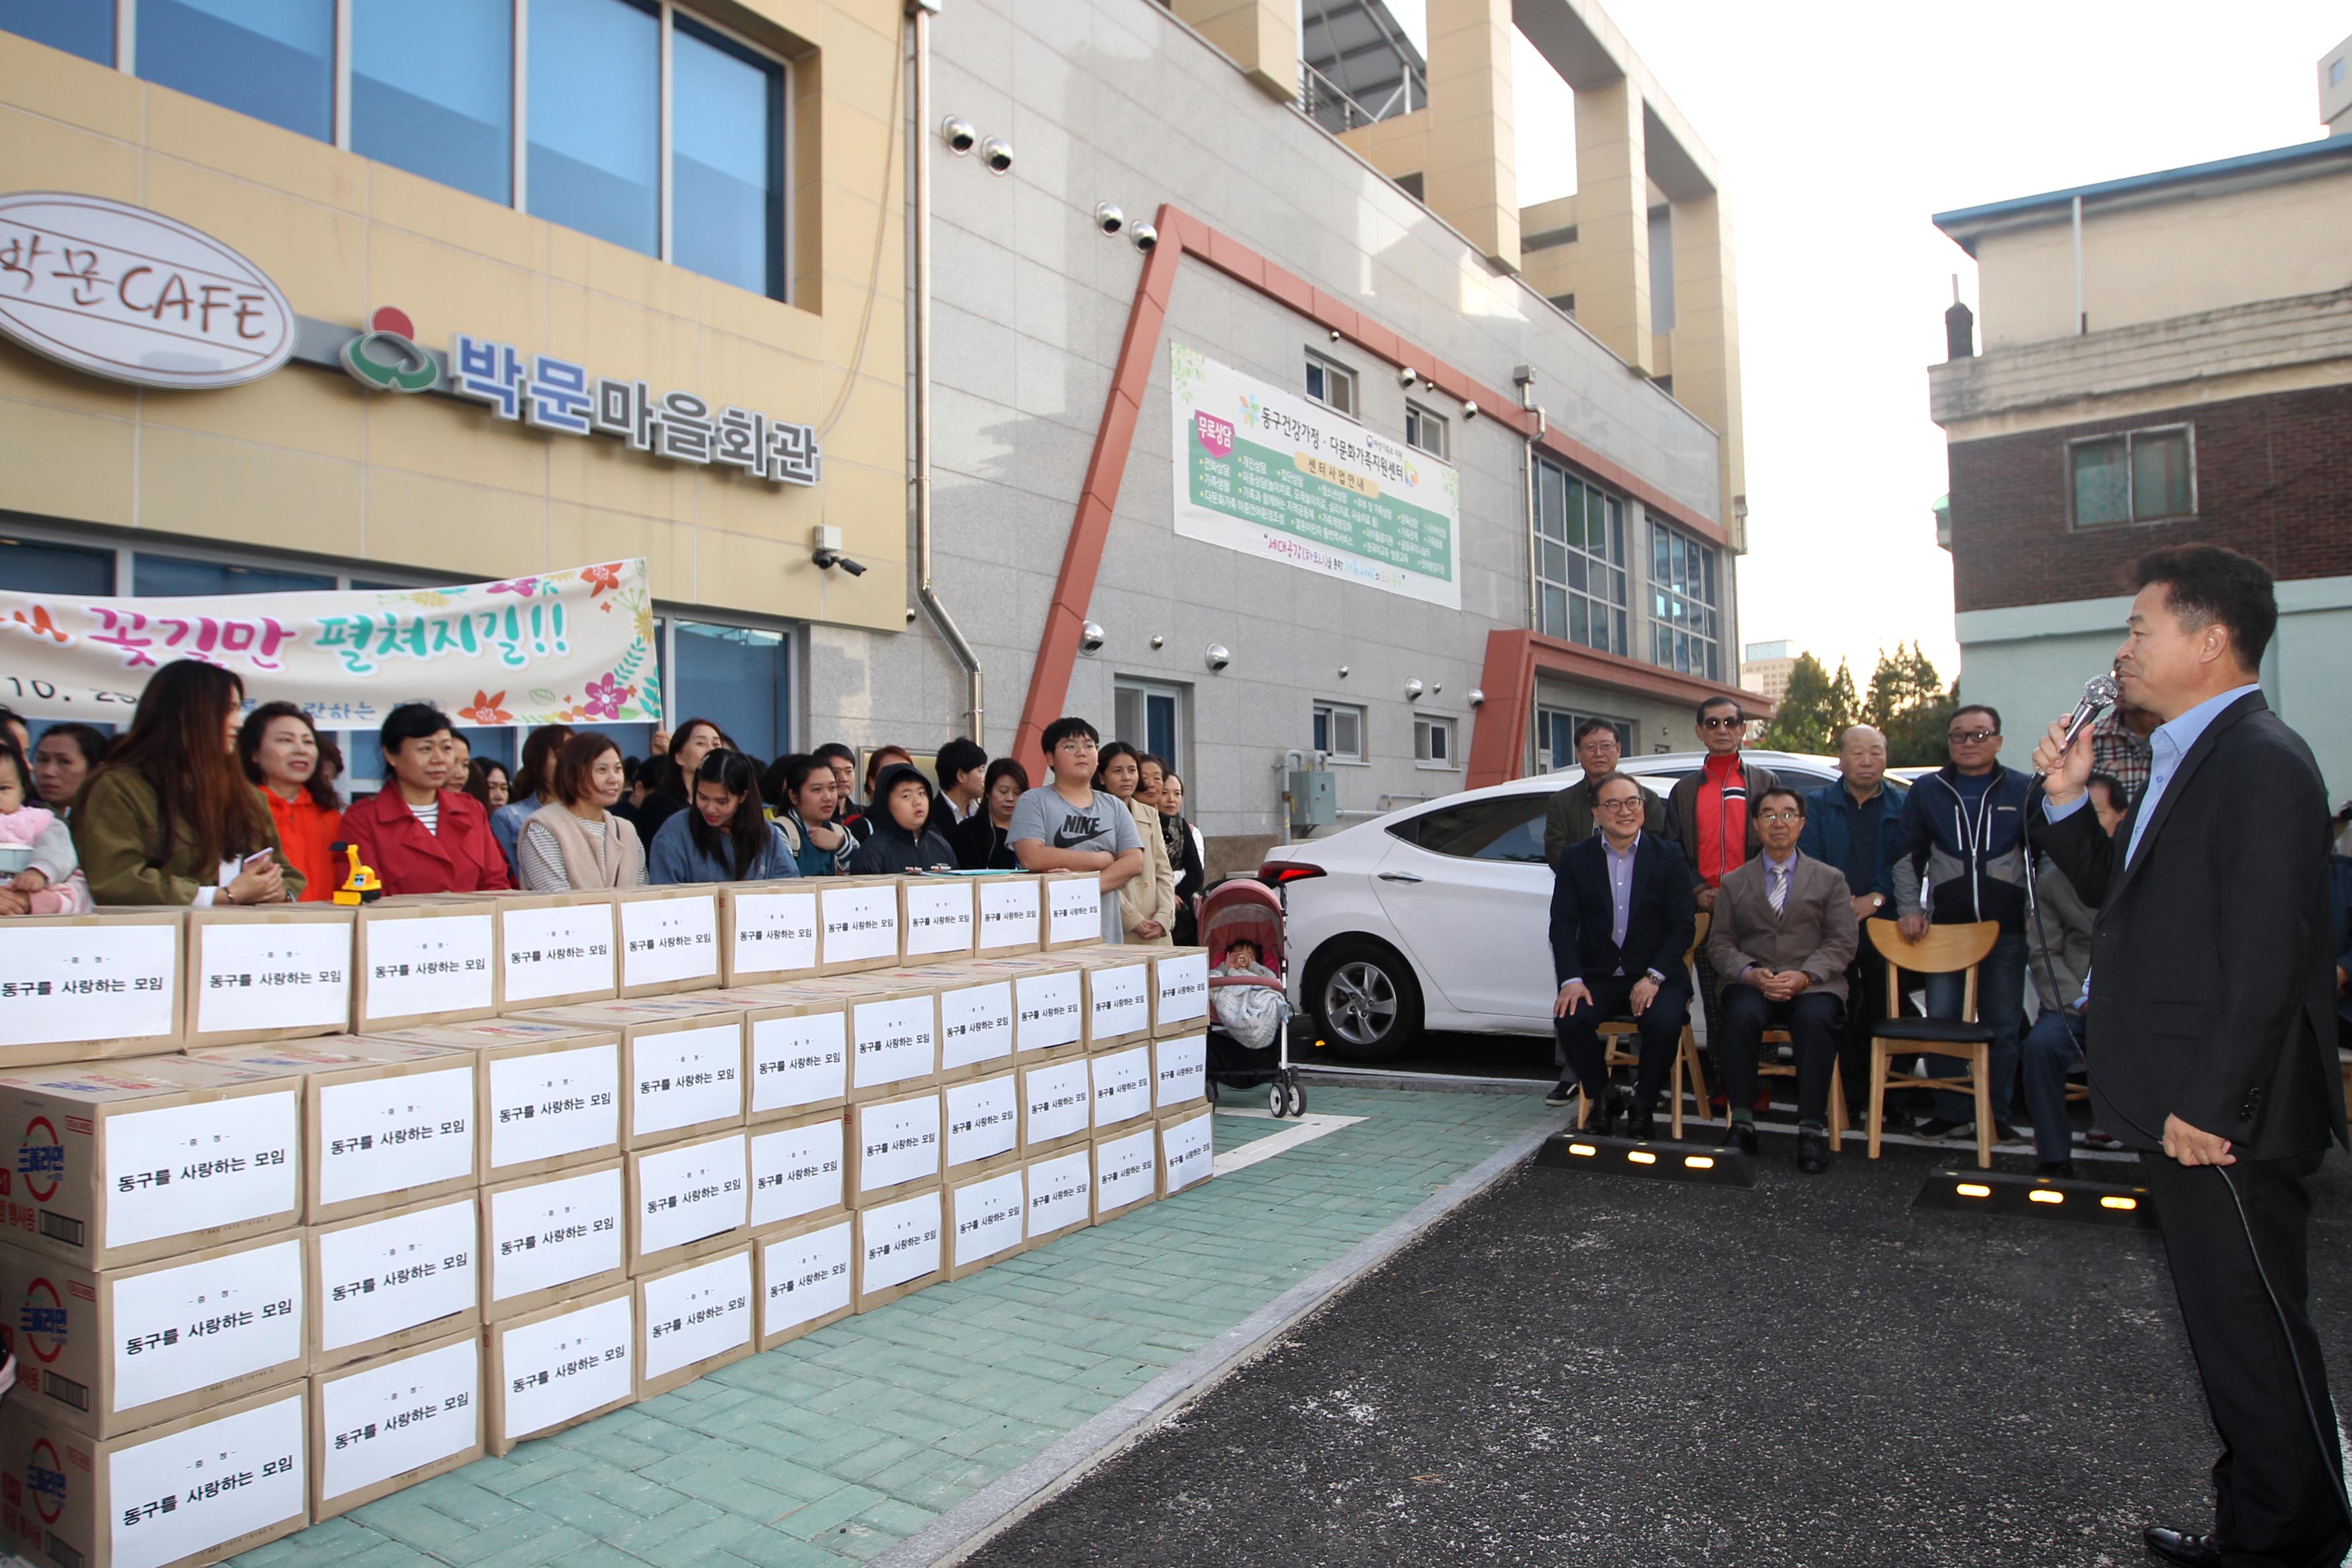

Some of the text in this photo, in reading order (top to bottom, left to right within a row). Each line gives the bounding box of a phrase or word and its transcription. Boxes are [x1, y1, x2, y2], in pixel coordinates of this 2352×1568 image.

[449, 333, 820, 487] 박문마을회관
[1198, 415, 1232, 448] 무료상담
[1261, 406, 1403, 483] 동구건강가정 다문화가족지원센터
[315, 602, 568, 673] 펼쳐지길!!
[1063, 814, 1100, 835] NIKE
[828, 918, 893, 934] 동구를 사랑하는 모임
[912, 914, 969, 928] 동구를 사랑하는 모임
[985, 910, 1036, 922] 동구를 사랑하는 모임
[629, 932, 711, 952] 동구를 사랑하는 모임
[740, 928, 812, 942] 동구를 사랑하는 모임
[510, 943, 607, 965] 동구를 사랑하는 모임
[209, 969, 342, 989] 동구를 사랑하는 모임
[374, 957, 486, 979] 동구를 사랑하는 모임
[0, 976, 164, 999] 동구를 사랑하는 모임
[1162, 983, 1205, 999] 동구를 사랑하는 모임
[1021, 1004, 1078, 1022] 동구를 사랑하는 모임
[1095, 995, 1144, 1012] 동구를 사랑하는 모임
[946, 1016, 1008, 1038] 동구를 사랑하는 모임
[859, 1032, 930, 1054] 동구를 사랑하는 모임
[759, 1052, 840, 1075] 동구를 사랑하는 모임
[640, 1067, 735, 1095] 동구를 사랑하는 모임
[1097, 1078, 1148, 1099] 동구를 사랑하는 모임
[499, 1091, 611, 1124] 동구를 사랑하는 모임
[1031, 1092, 1086, 1114] 동구를 사랑하는 모임
[952, 1110, 1013, 1134] 동구를 사랑하는 모임
[330, 1118, 465, 1156] 동구를 사랑하는 모임
[866, 1132, 935, 1157] 동구를 사랑하는 모임
[1169, 1142, 1210, 1167] 동구를 사랑하는 모임
[117, 1148, 285, 1193] 동구를 사랑하는 모임
[758, 1159, 838, 1190] 동구를 사랑하는 모임
[1101, 1160, 1152, 1185] 동구를 사랑하는 모임
[646, 1177, 742, 1214] 동구를 사랑하는 모임
[1032, 1183, 1087, 1208] 동구를 사랑하는 모임
[959, 1206, 1020, 1234] 동구를 사랑하는 모임
[500, 1216, 614, 1256] 동구를 사랑하는 모임
[868, 1229, 936, 1260] 동구를 사랑하는 모임
[331, 1251, 467, 1302] 동구를 사랑하는 모임
[770, 1262, 846, 1298] 동구를 사랑하는 모임
[124, 1298, 292, 1356] 동구를 사랑하는 모임
[652, 1295, 746, 1339] 동구를 사랑하는 모임
[512, 1344, 625, 1394] 동구를 사랑하는 모임
[333, 1391, 469, 1451] 동구를 사랑하는 모임
[122, 1454, 293, 1527] 동구를 사랑하는 모임
